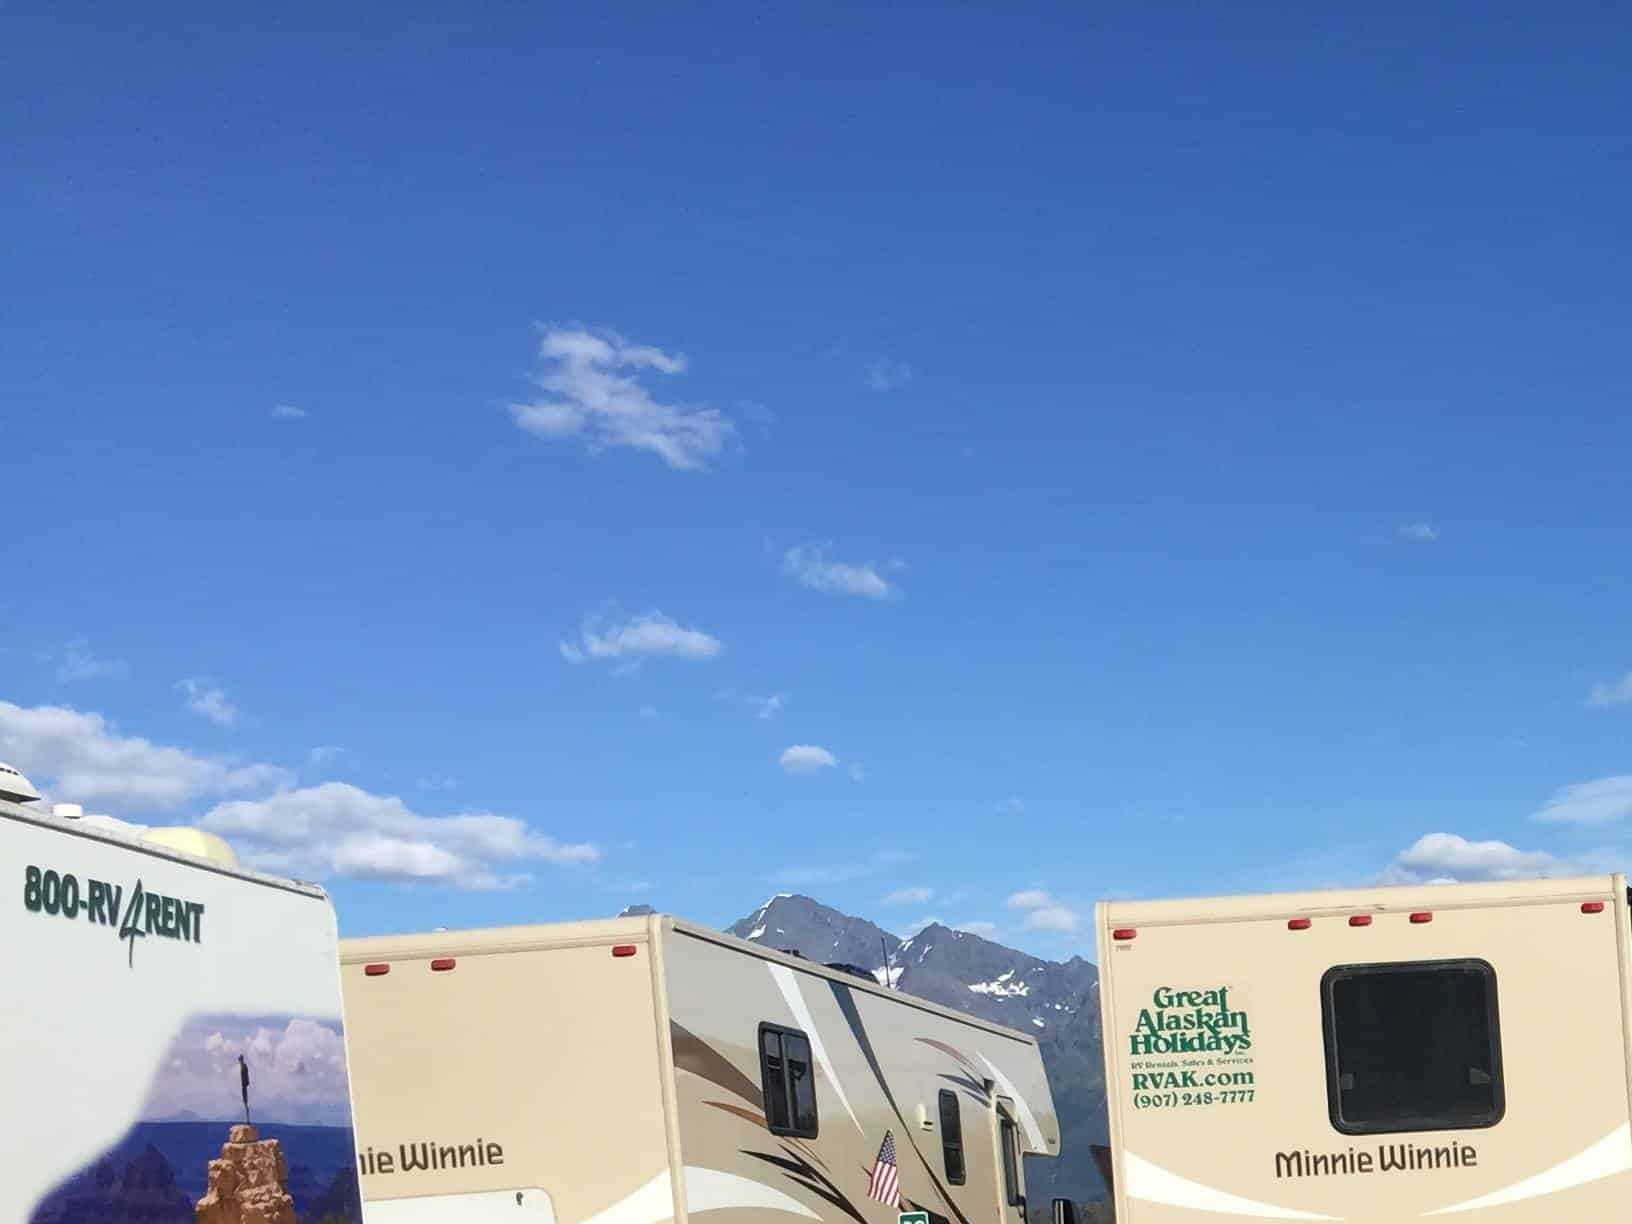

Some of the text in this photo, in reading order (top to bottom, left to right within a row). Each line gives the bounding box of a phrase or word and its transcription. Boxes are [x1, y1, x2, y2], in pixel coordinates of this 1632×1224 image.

[1153, 986, 1229, 1012] Great
[1135, 1008, 1251, 1038] Alaskan
[1129, 1031, 1252, 1055] Holidays
[1132, 1070, 1255, 1090] RVAK.com
[1134, 1089, 1255, 1109] (907) 248-7777
[400, 1138, 504, 1171] Winnie
[1275, 1141, 1478, 1178] Minnie Winnie
